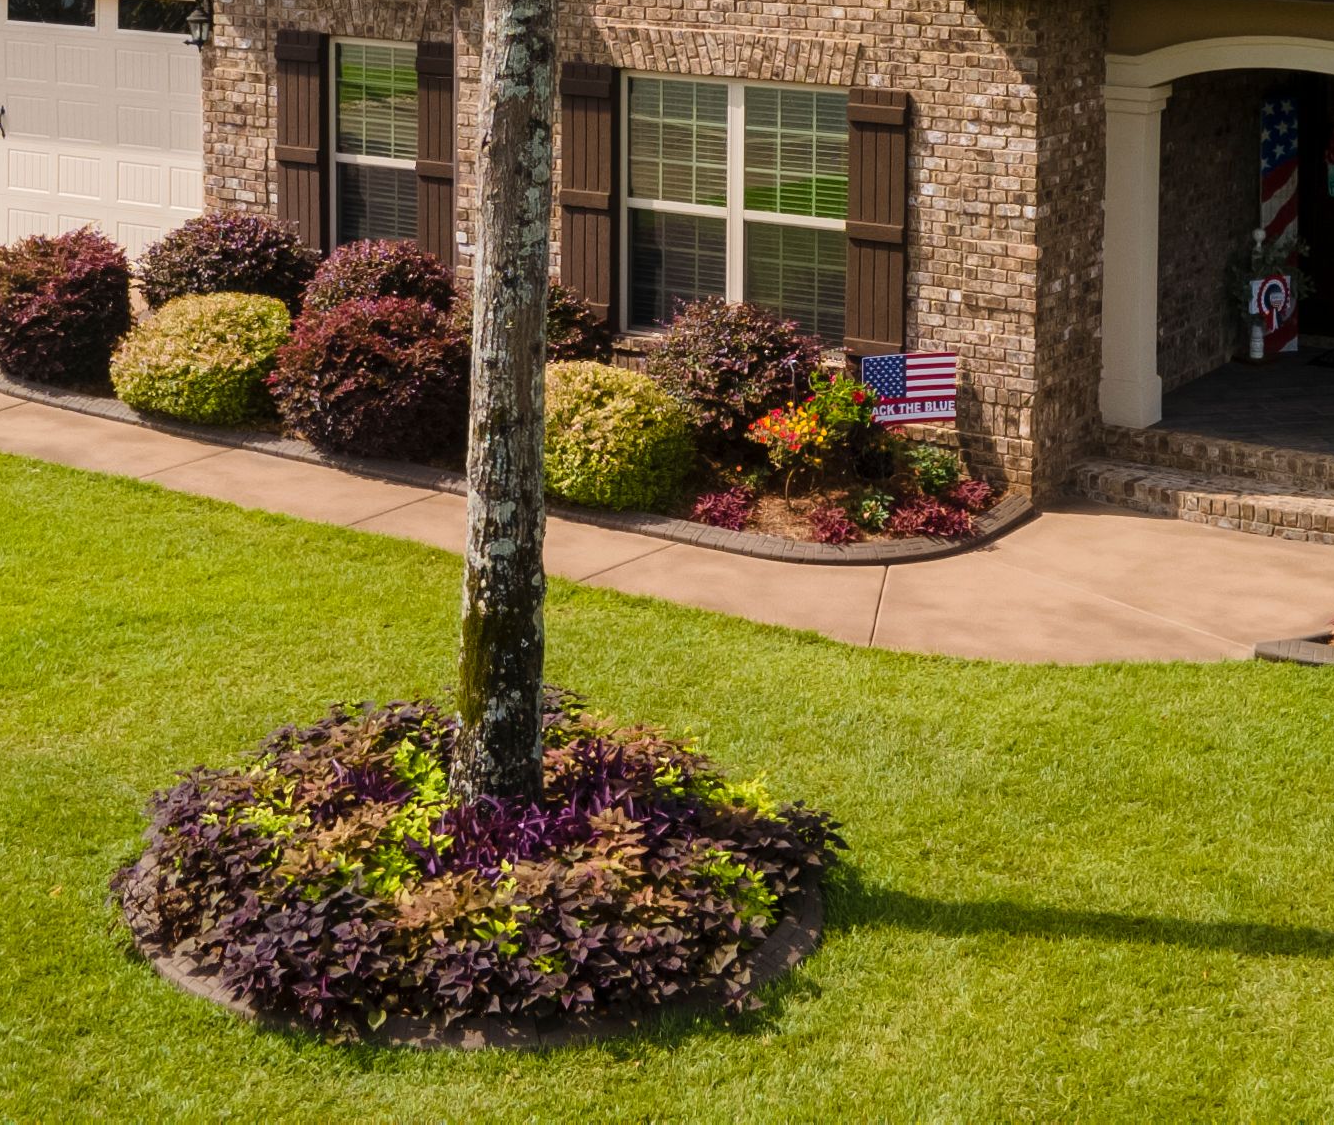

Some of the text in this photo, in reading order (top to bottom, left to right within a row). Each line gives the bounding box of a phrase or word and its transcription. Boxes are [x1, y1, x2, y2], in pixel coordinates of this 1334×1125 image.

[872, 400, 956, 416] ACK THE BLUE
